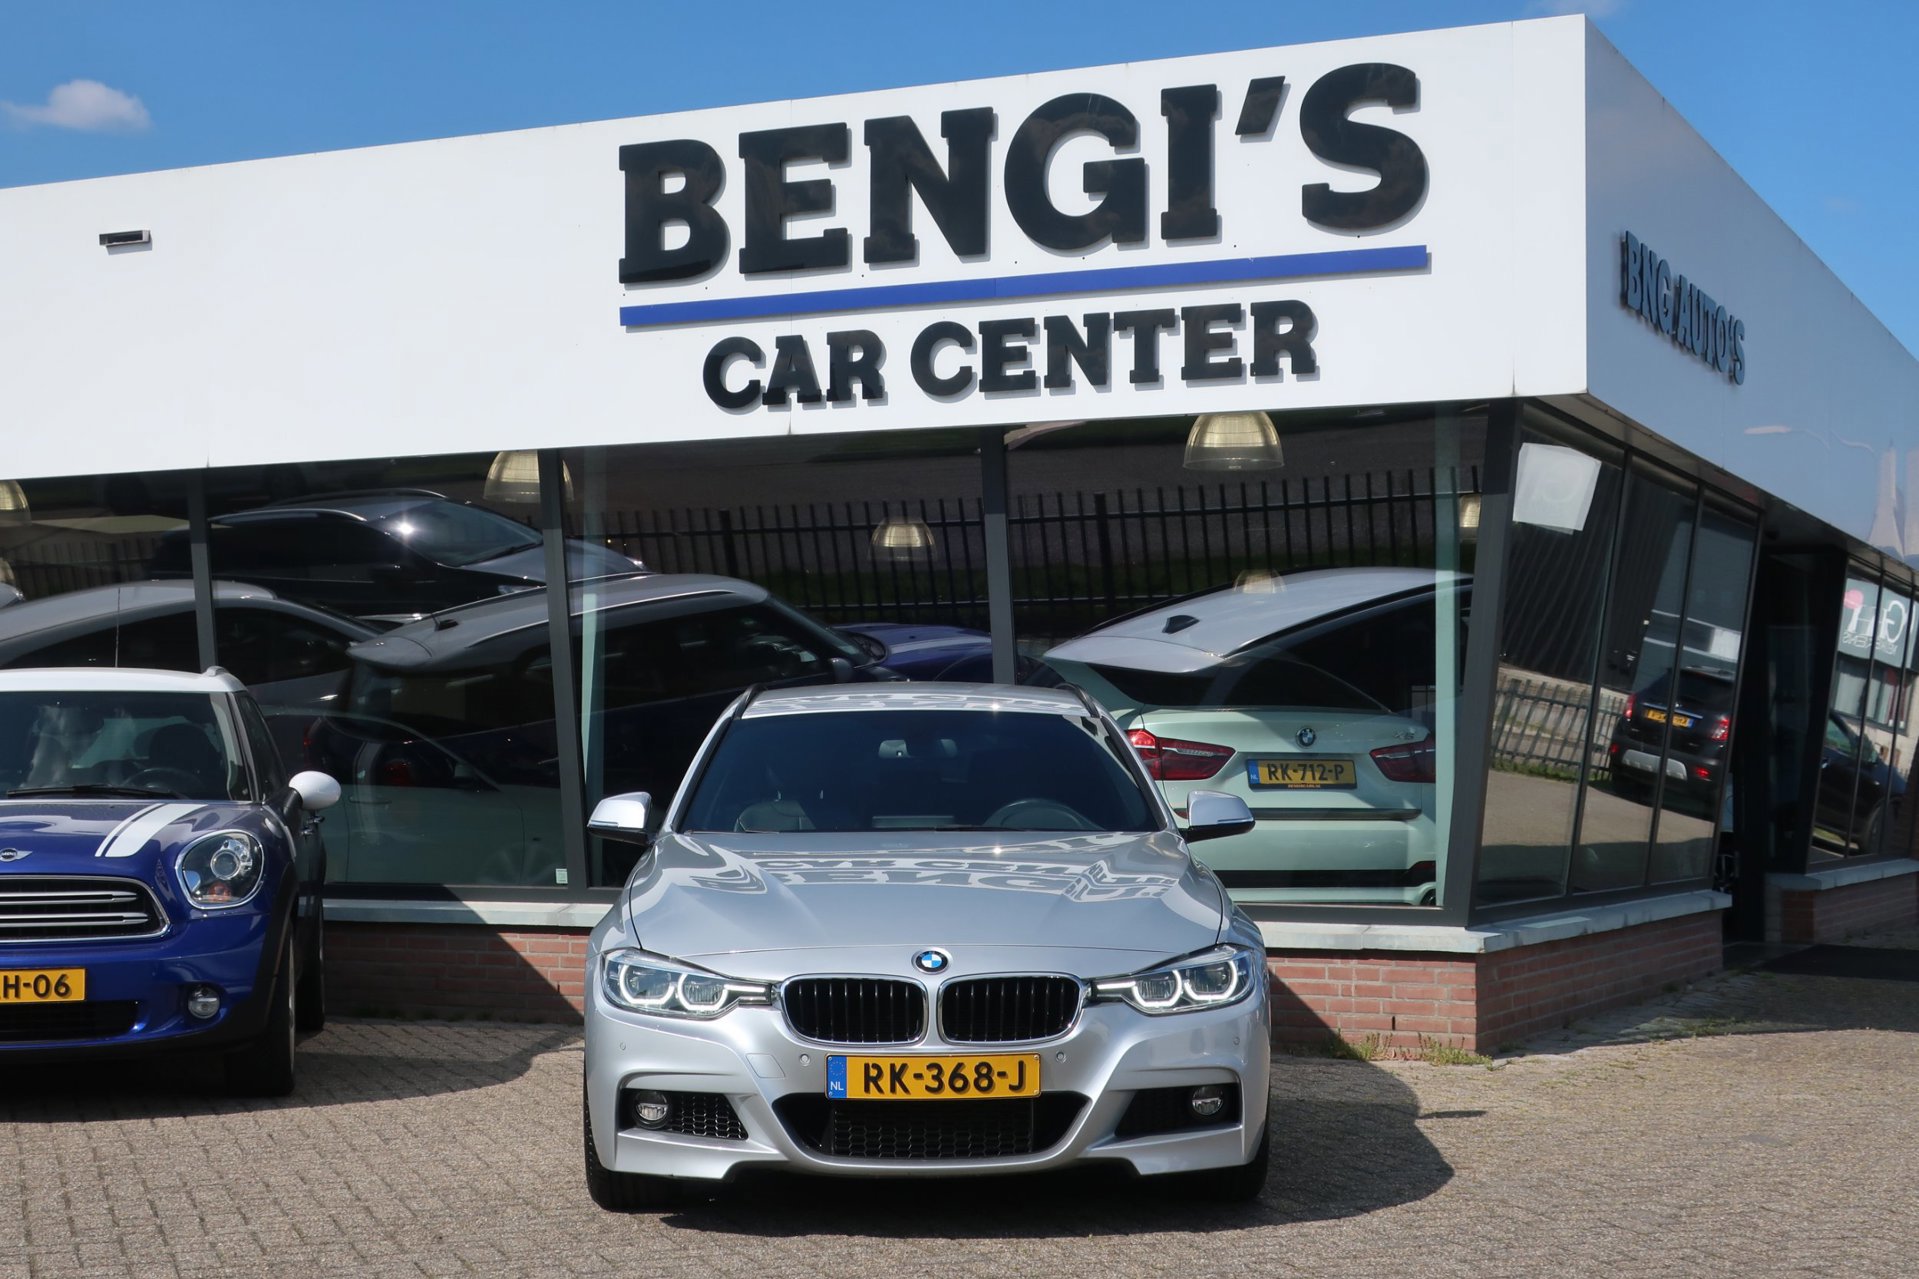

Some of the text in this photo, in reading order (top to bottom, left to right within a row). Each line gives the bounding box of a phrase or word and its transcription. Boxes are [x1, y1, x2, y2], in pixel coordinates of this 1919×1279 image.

[618, 61, 1428, 284] BENGI'S
[1624, 230, 1745, 386] BNG AUTO'S
[702, 299, 1317, 409] CAR CENTER
[1266, 763, 1344, 781] RK-712-P
[829, 1081, 845, 1091] NL
[863, 1060, 1026, 1095] RK-368-J
